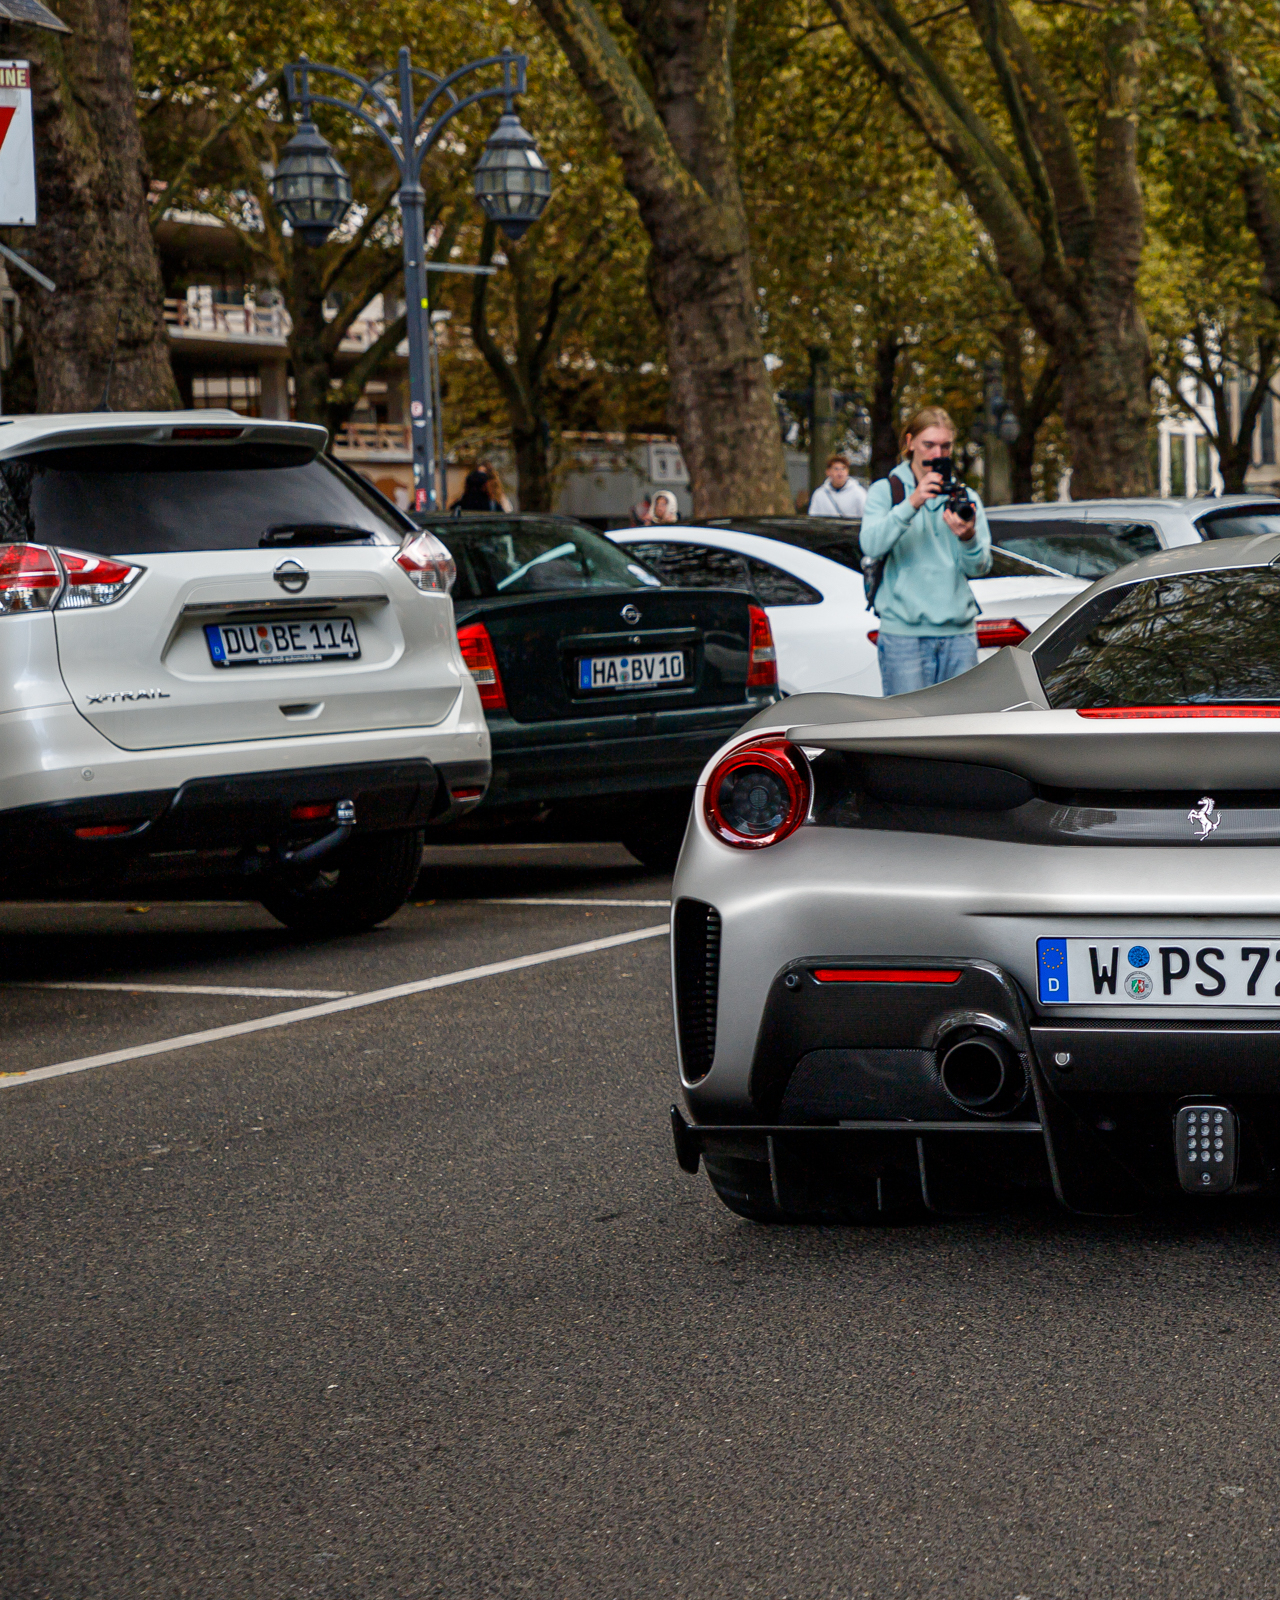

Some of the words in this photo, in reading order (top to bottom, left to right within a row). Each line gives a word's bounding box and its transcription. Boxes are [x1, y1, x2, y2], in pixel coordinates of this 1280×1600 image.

[222, 628, 259, 654] DU
[271, 625, 307, 651] BE
[309, 622, 354, 650] 114
[593, 661, 618, 684] HA
[632, 658, 655, 681] BV
[659, 656, 681, 679] 10
[86, 688, 170, 705] X-TRAIL
[1048, 977, 1060, 992] D
[1089, 946, 1119, 995] W
[1158, 946, 1226, 997] PS
